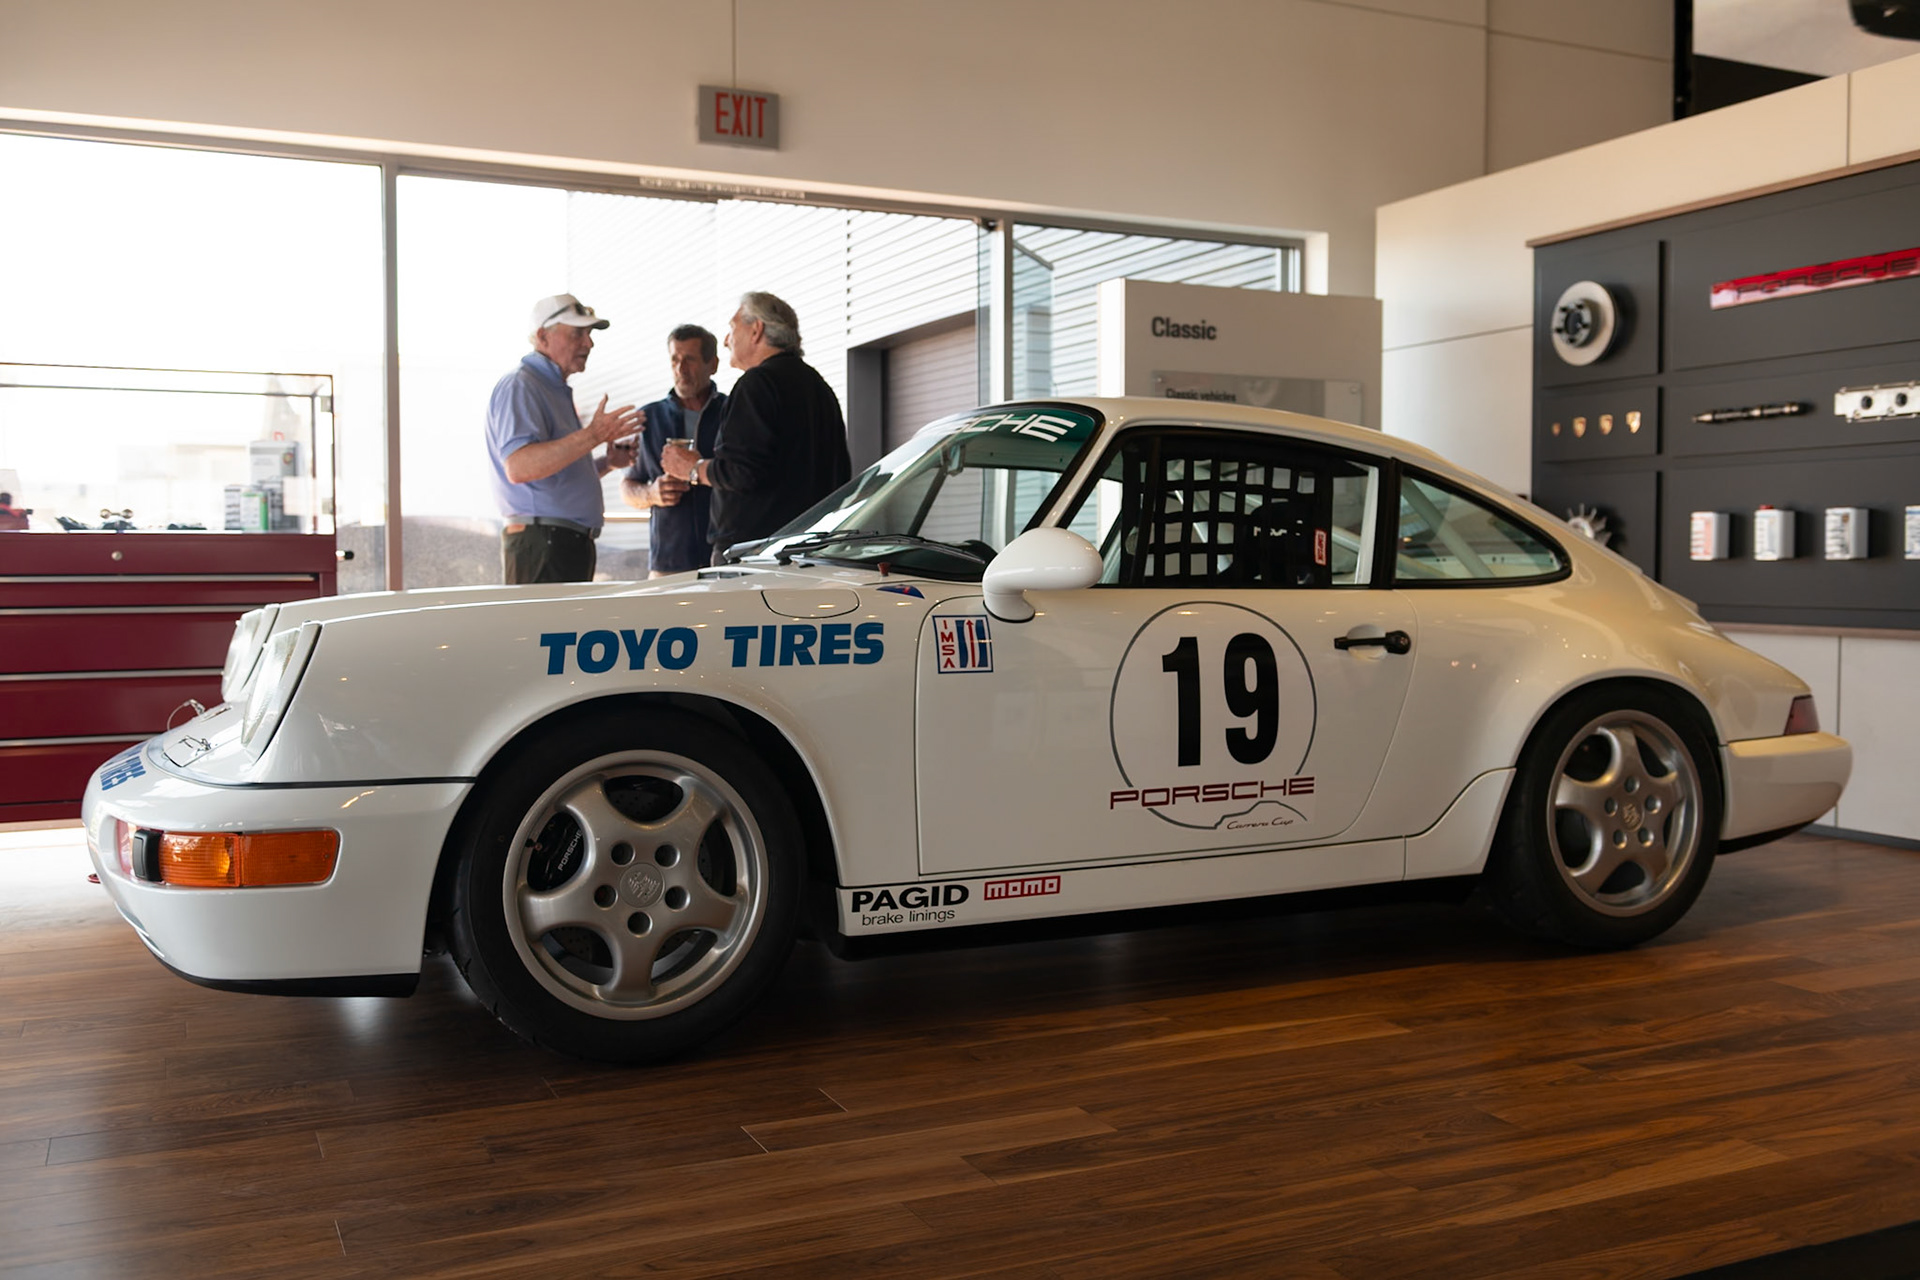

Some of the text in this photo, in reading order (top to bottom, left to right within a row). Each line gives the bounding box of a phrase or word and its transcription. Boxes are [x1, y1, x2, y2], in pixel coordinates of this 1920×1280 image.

[715, 92, 768, 139] EXIT
[1736, 256, 1918, 300] PORSCHE
[1151, 315, 1217, 341] Classic
[540, 621, 884, 675] TOYO TIRES
[940, 619, 956, 669] IMSA
[1161, 632, 1280, 767] 19
[1109, 776, 1316, 810] PORSCHE
[1226, 816, 1294, 830] Carrera Cup
[851, 884, 970, 913] PAGID
[862, 908, 956, 926] brake linings
